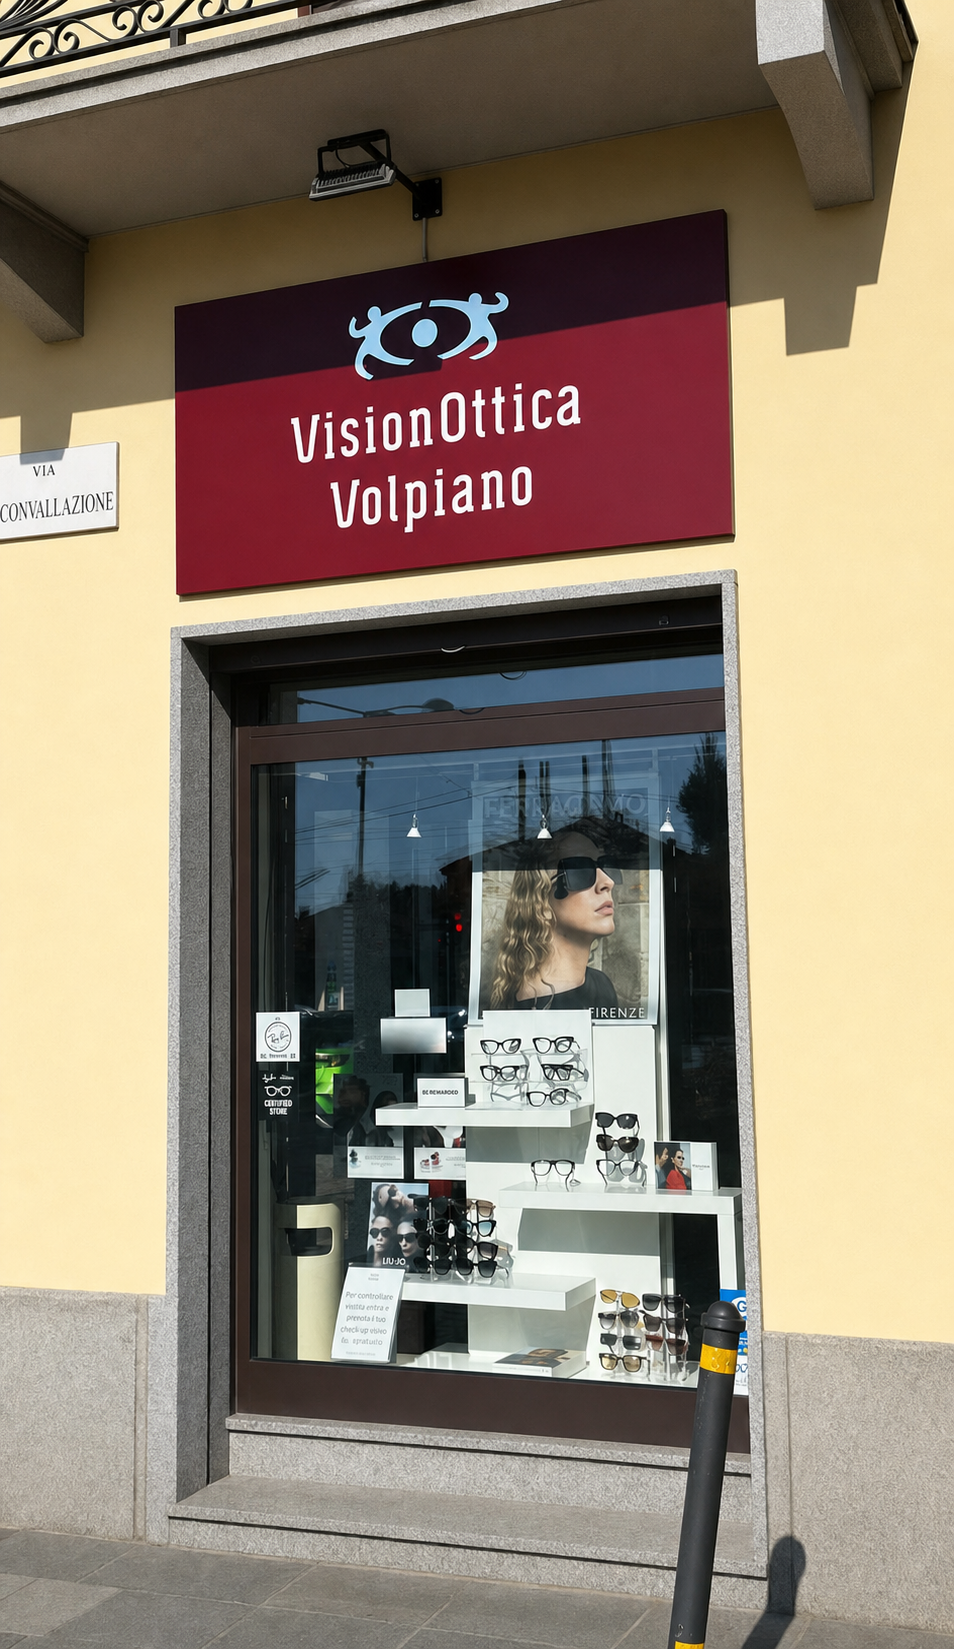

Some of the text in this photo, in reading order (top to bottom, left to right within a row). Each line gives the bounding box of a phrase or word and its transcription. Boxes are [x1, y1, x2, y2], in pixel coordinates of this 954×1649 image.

[291, 383, 581, 463] VisionOttica
[33, 464, 56, 477] VIA
[0, 491, 114, 523] CONVALLAZIONE
[330, 466, 533, 533] Volpiano
[589, 1007, 646, 1018] FIRENZE
